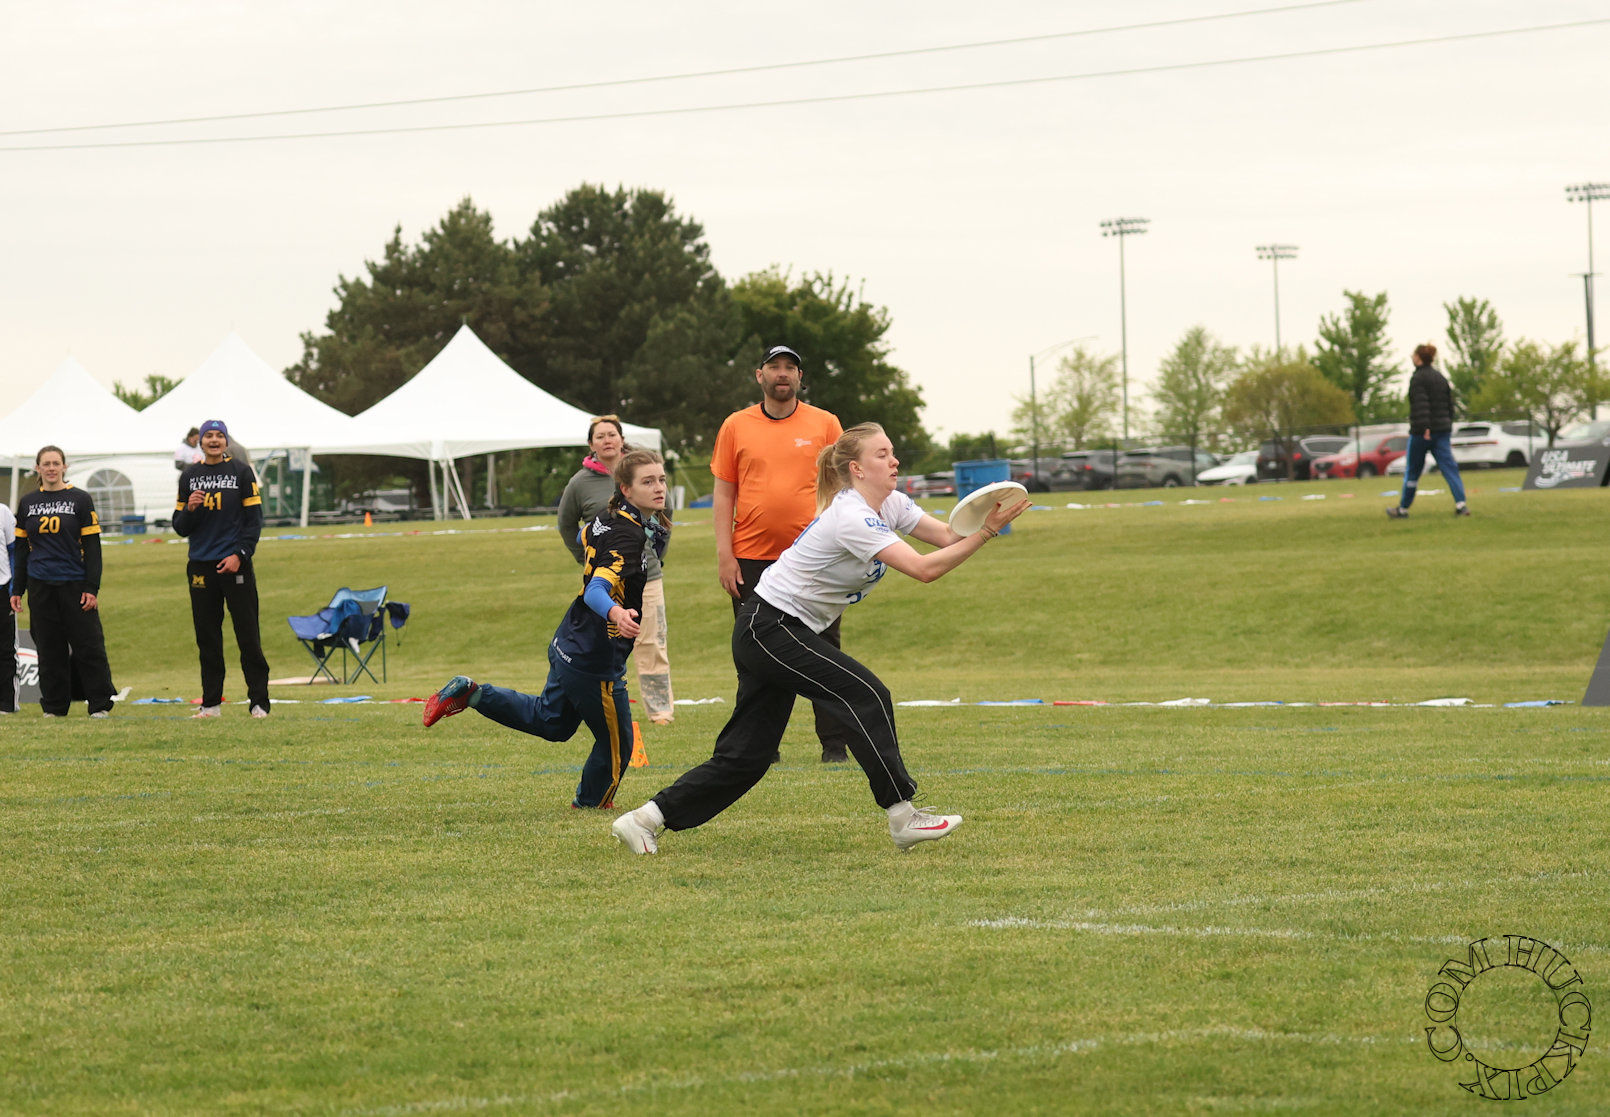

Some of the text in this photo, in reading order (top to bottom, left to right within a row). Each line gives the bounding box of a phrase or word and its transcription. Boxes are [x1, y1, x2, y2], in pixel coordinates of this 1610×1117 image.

[1541, 449, 1569, 464] USA
[189, 474, 237, 484] MICHIGAN
[189, 480, 239, 491] FLYWHEEL
[28, 501, 75, 510] MICHIGAN
[203, 491, 222, 511] 41
[27, 505, 76, 517] FLYWHEEL
[39, 516, 61, 534] 20
